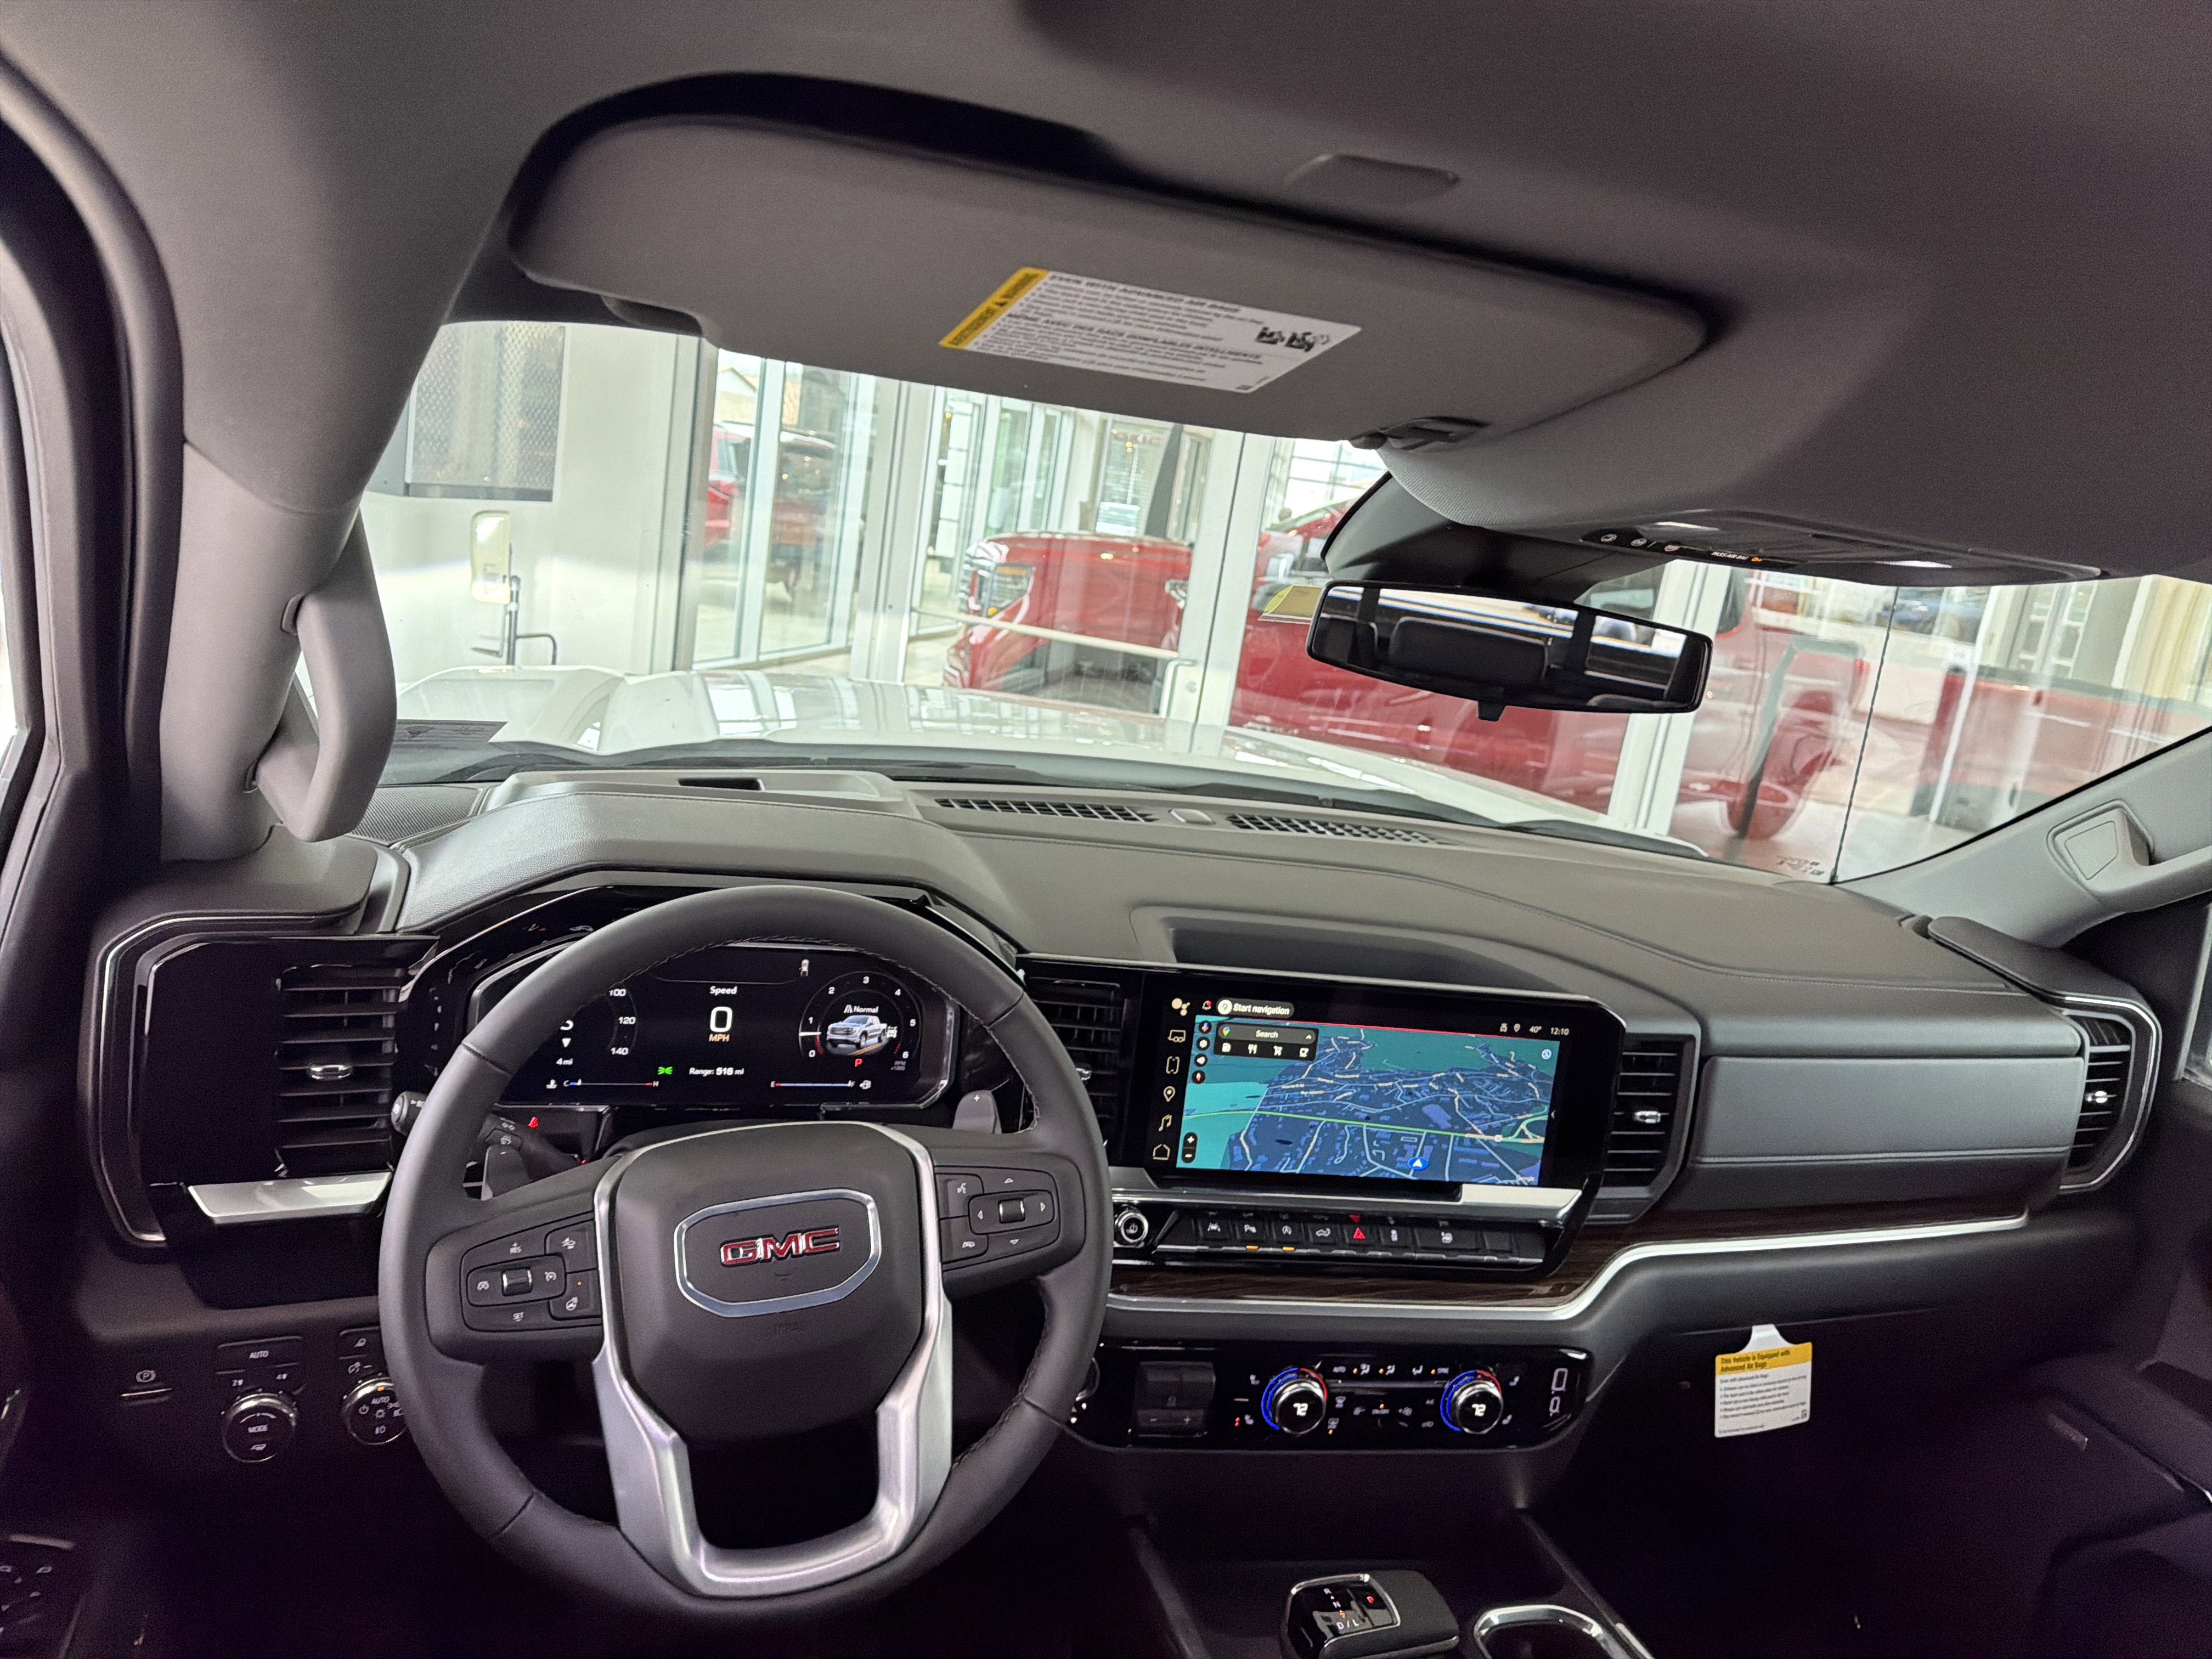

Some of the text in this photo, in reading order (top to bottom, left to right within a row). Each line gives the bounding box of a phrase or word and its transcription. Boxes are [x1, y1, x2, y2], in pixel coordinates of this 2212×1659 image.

[609, 989, 626, 997] 100
[709, 986, 737, 996] Speed
[828, 986, 835, 995] 2
[1233, 1003, 1290, 1015] Start navigation
[710, 1006, 732, 1032] 0
[1255, 1030, 1279, 1039] Search
[1550, 1027, 1570, 1036] 12:10
[709, 1034, 730, 1042] MPH
[611, 1047, 629, 1056] 140
[808, 1049, 816, 1058] 0
[855, 1058, 863, 1068] P
[689, 1068, 714, 1077] Range:
[721, 1227, 839, 1266] GMC
[249, 1350, 269, 1359] AUTO
[371, 1396, 390, 1404] AUTO
[1293, 1403, 1308, 1417] 72
[1471, 1403, 1486, 1417] 72
[248, 1425, 268, 1433] MODE
